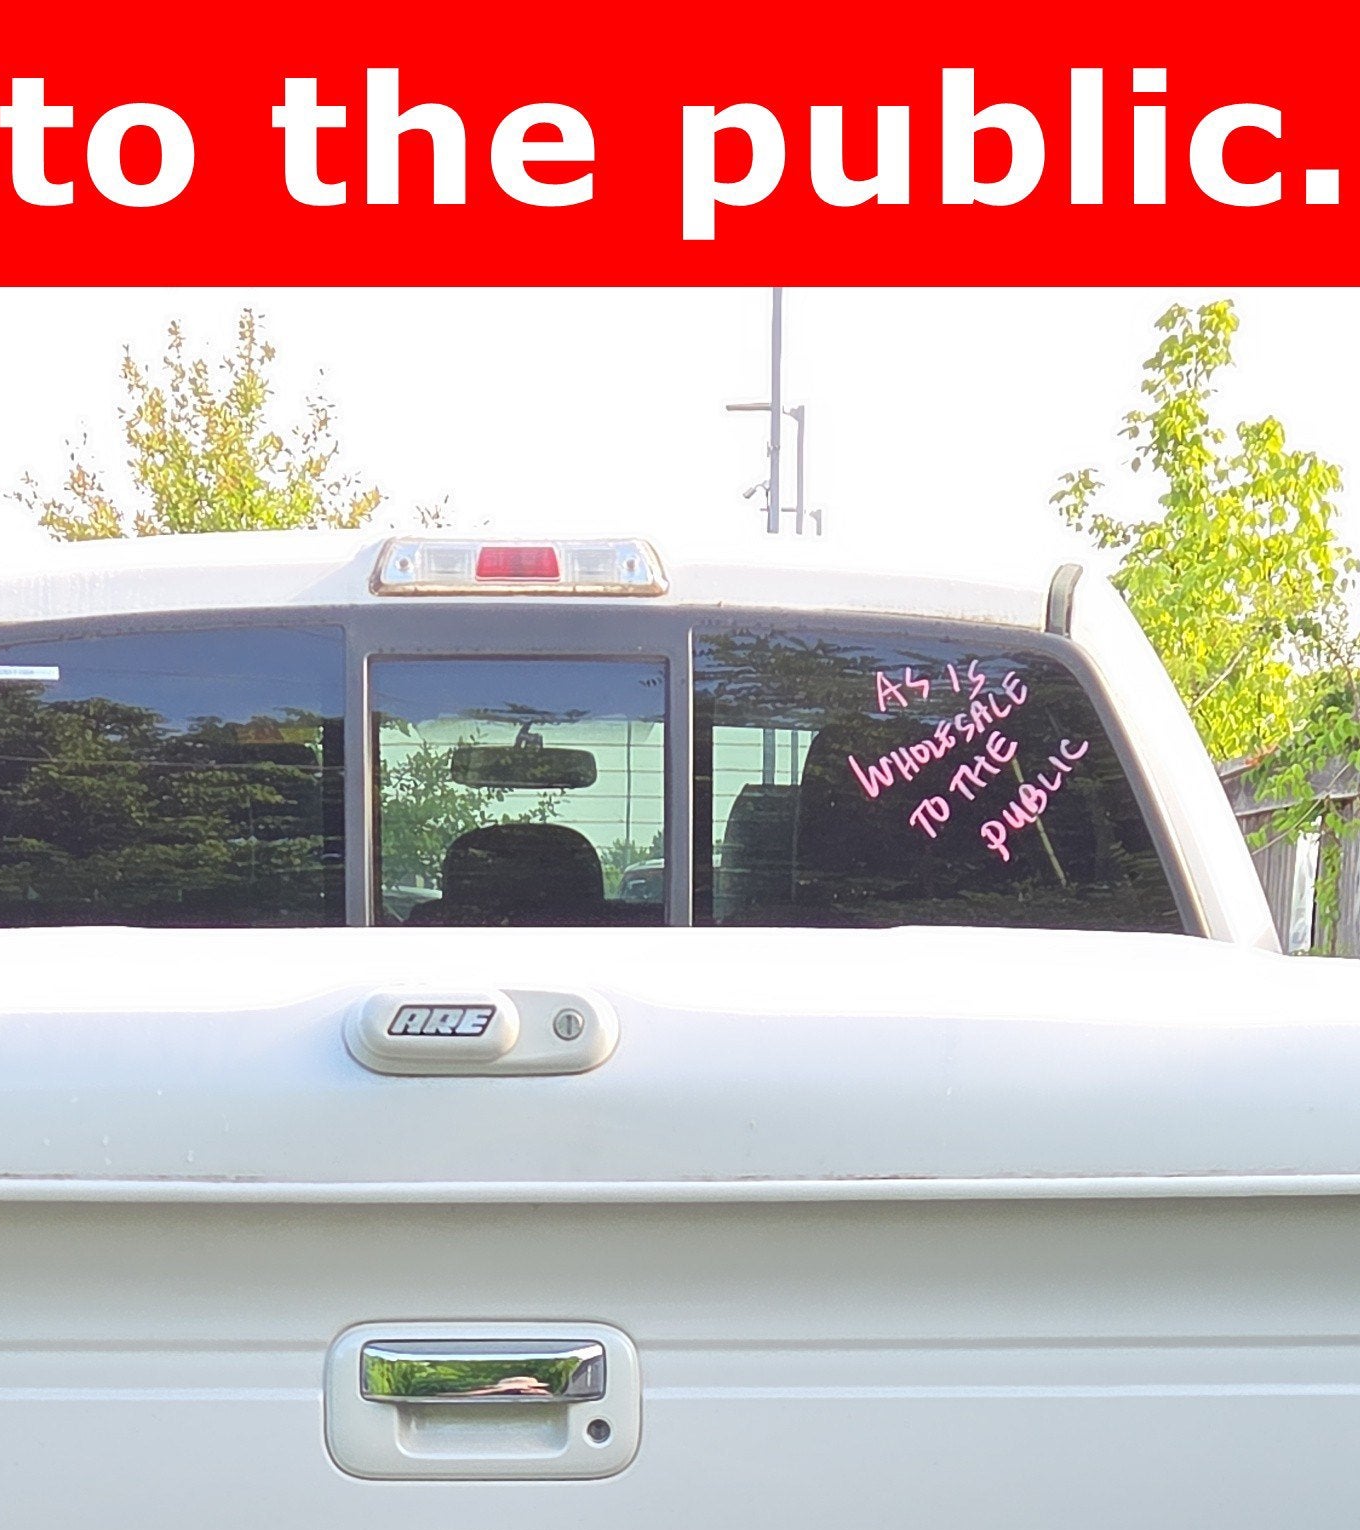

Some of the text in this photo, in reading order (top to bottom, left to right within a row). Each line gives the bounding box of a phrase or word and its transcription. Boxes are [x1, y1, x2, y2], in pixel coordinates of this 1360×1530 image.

[848, 671, 1029, 800] WHOLESALE
[876, 659, 987, 712] AS IS
[909, 730, 1019, 839] TO THE
[980, 738, 1090, 862] PUBLIC
[390, 1005, 495, 1035] ARE
